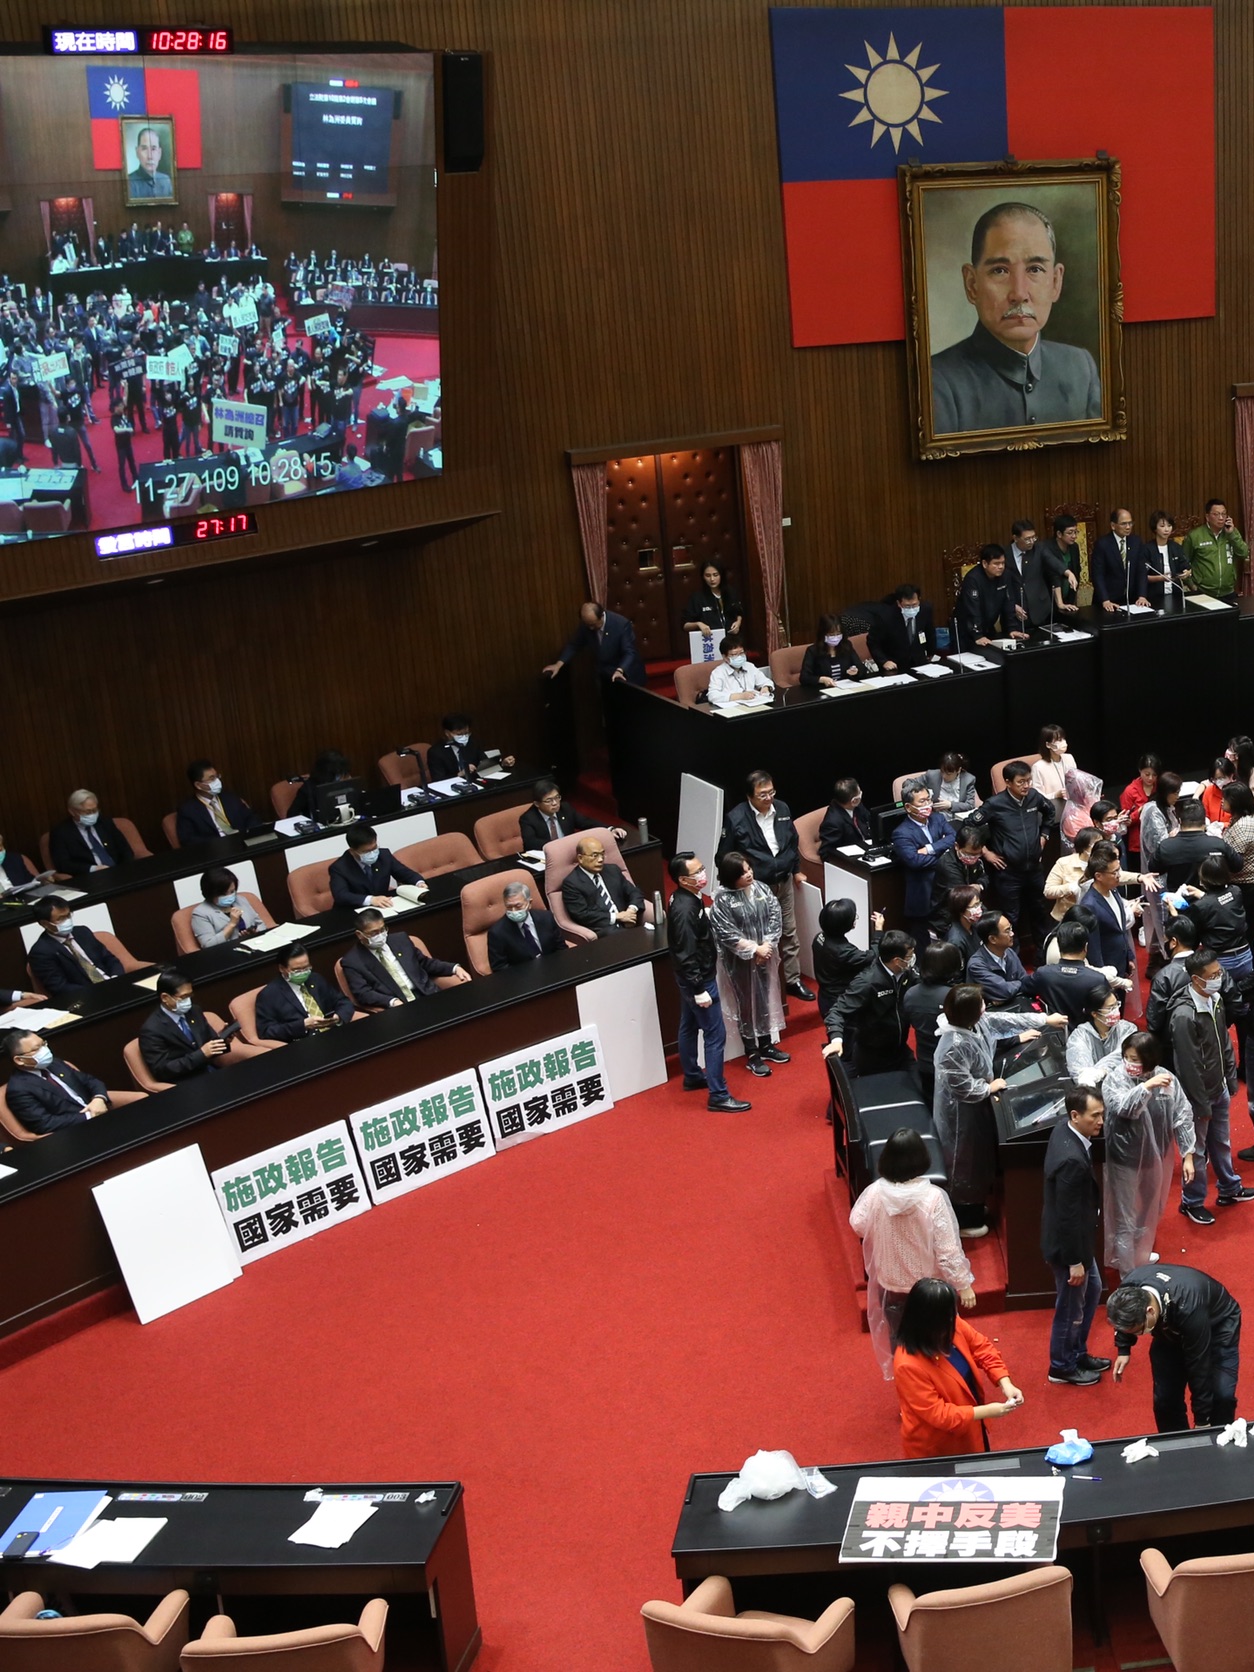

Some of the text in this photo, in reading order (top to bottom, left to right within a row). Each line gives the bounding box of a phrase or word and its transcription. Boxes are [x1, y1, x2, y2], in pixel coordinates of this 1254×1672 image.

[54, 31, 136, 52] 現在時間
[150, 31, 228, 51] 10:28:16
[132, 452, 334, 504] 11-27-109 10:28:15
[197, 514, 248, 538] 27:17
[96, 527, 171, 556] 發言時間
[877, 989, 894, 998] 2020
[488, 1039, 599, 1102] 施政報告
[359, 1084, 480, 1152] 施政報告
[497, 1073, 607, 1140] 國家需要
[369, 1119, 487, 1191] 國家需要
[220, 1136, 350, 1213] 施政報告
[232, 1172, 362, 1254] 國家需要
[386, 1493, 407, 1501] 003
[863, 1501, 1043, 1529] 親中反美
[858, 1529, 1040, 1558] 不擇手段
